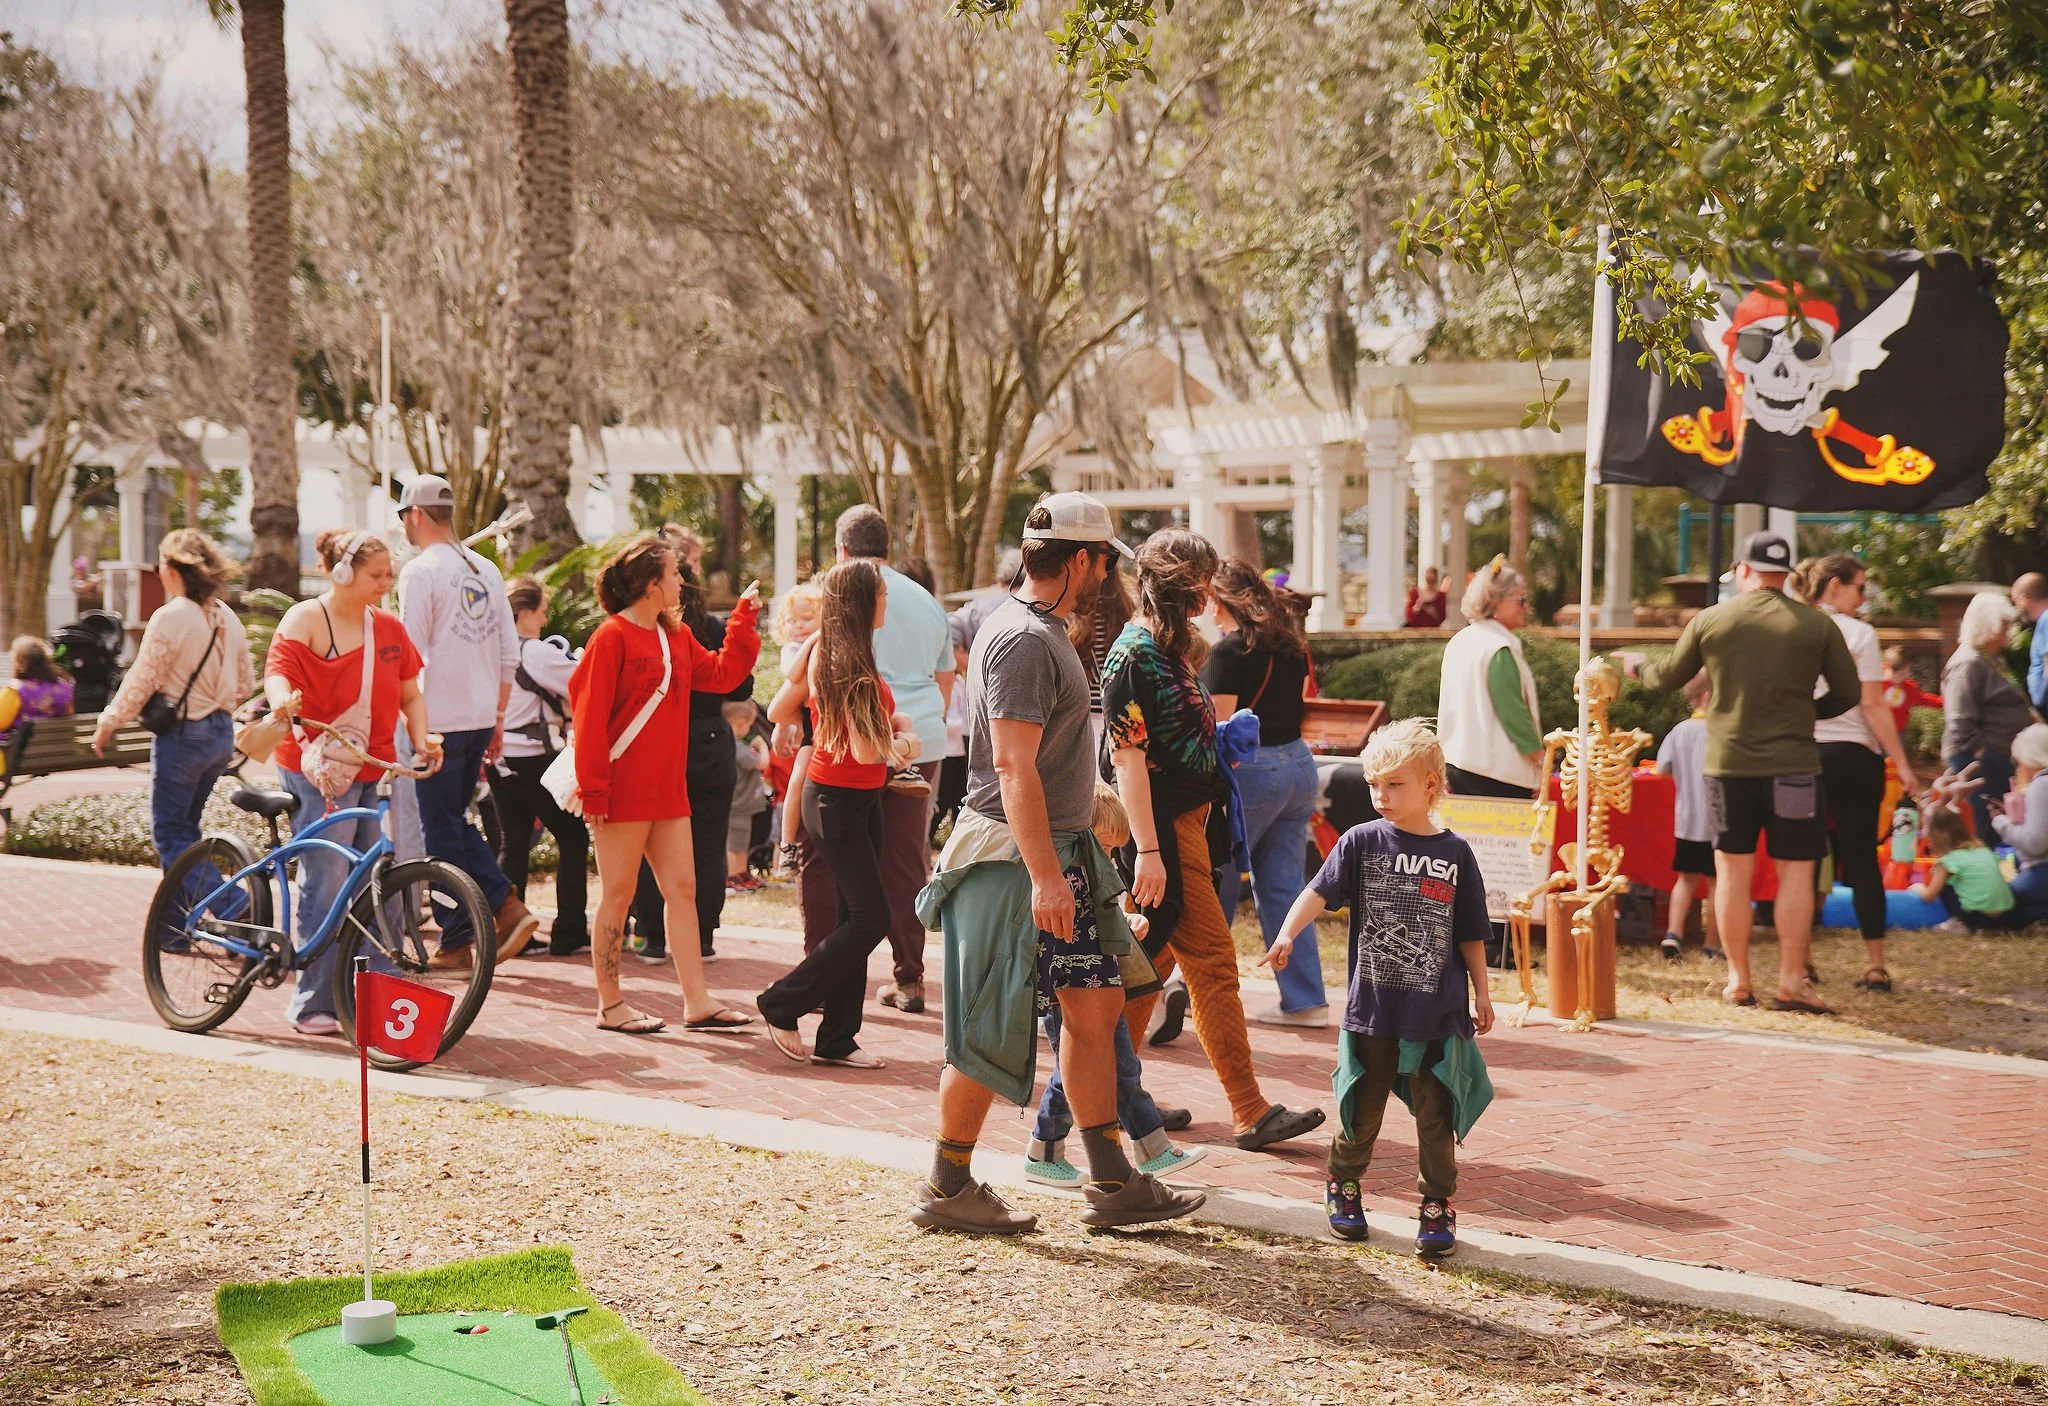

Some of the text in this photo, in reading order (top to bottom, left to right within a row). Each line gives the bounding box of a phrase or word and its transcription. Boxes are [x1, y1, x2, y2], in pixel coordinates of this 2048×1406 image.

[1498, 838, 1517, 848] FUN
[1394, 853, 1458, 886] NASA
[385, 998, 420, 1040] 3
